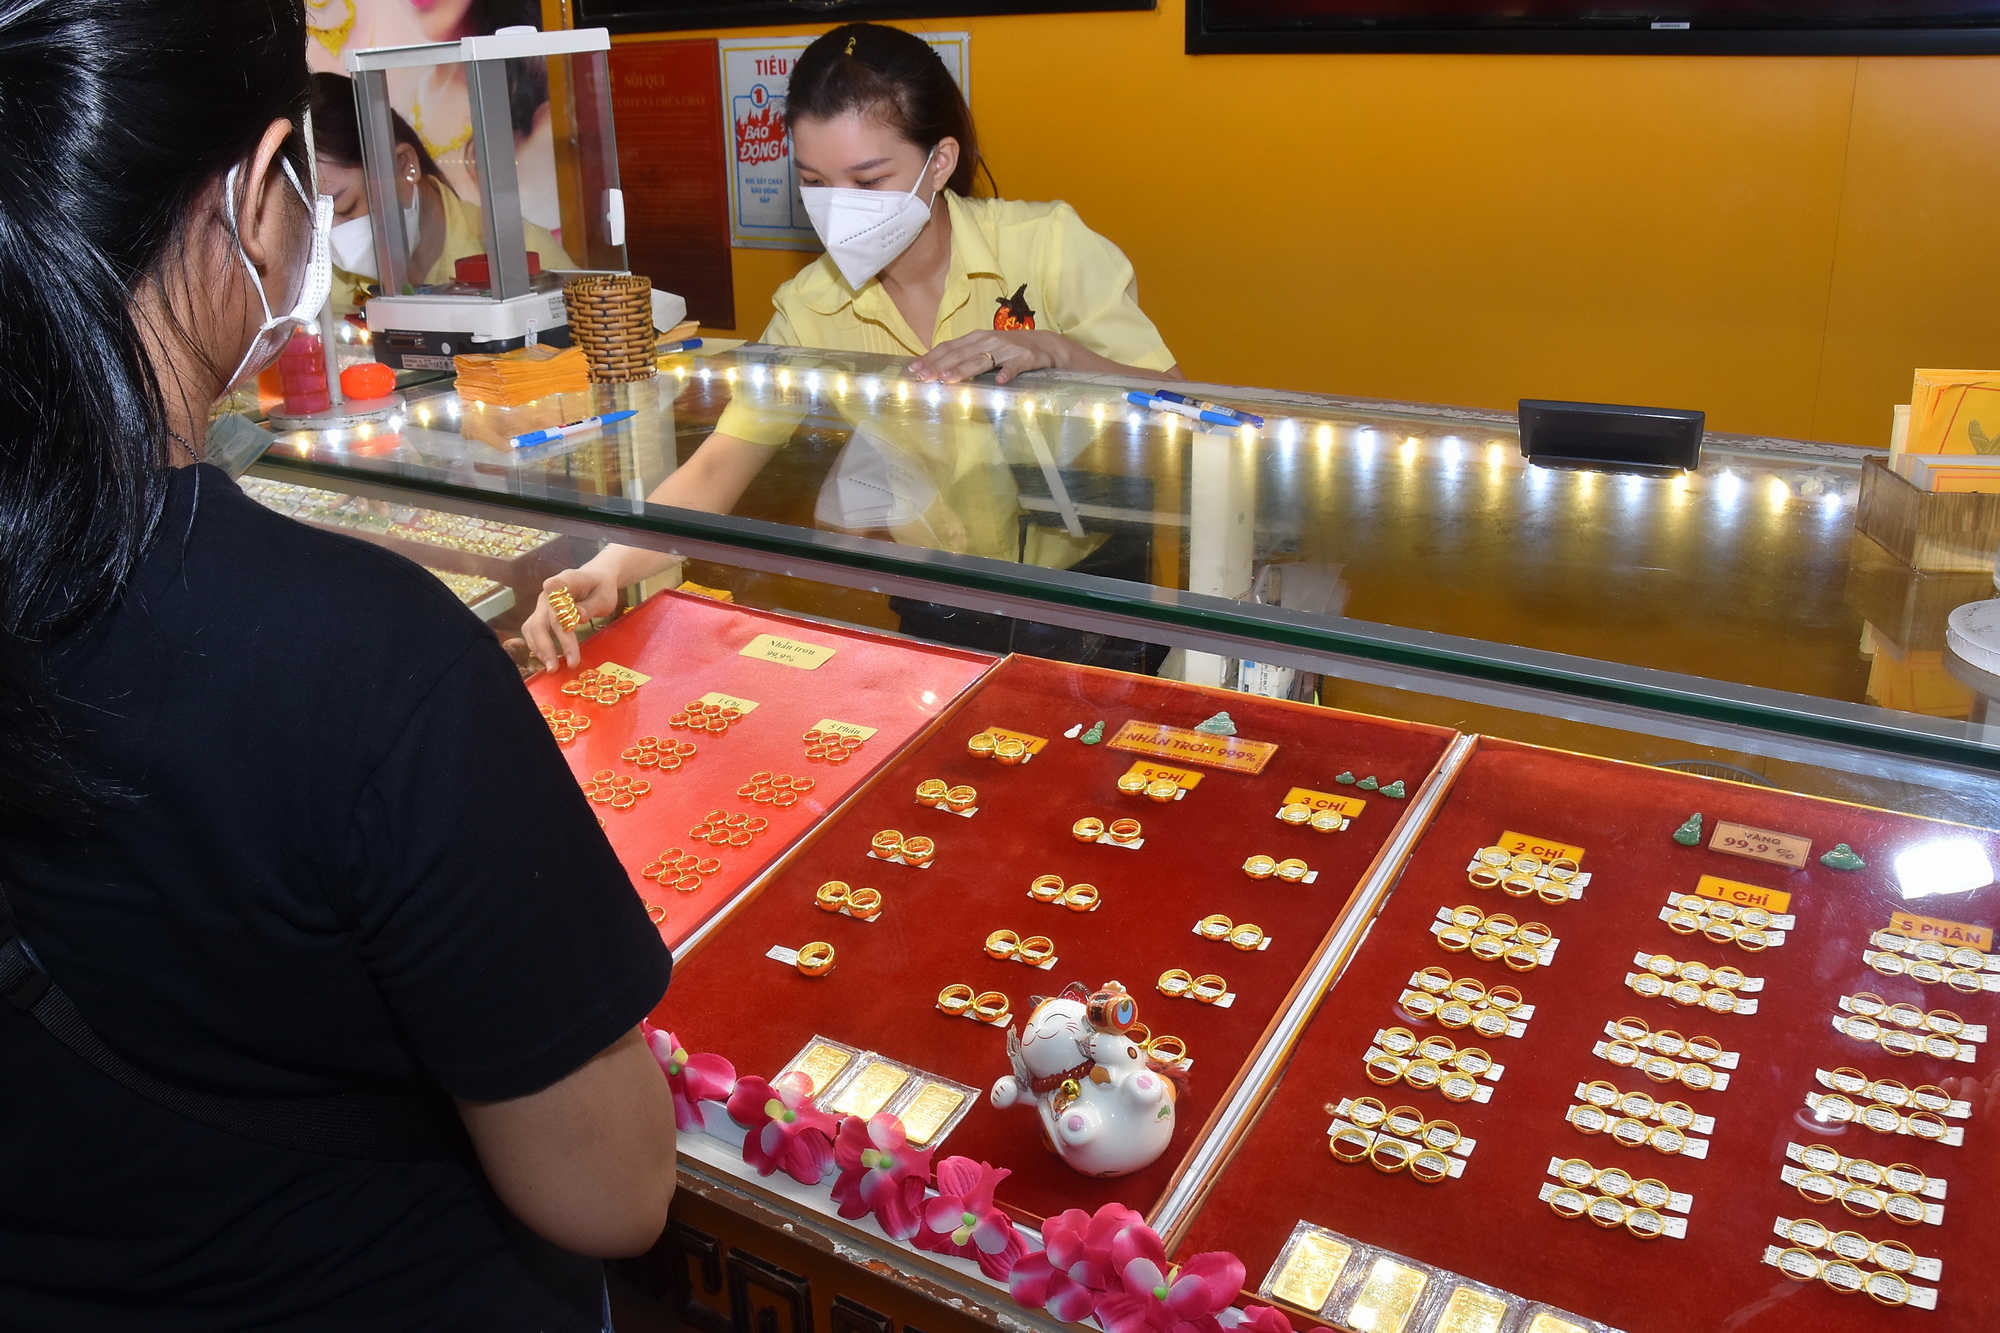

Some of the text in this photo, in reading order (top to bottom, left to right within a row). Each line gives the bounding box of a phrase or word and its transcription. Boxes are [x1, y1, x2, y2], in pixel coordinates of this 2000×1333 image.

[755, 55, 787, 76] TIÊU
[754, 88, 763, 104] 1
[745, 122, 769, 140] BÁO
[740, 140, 779, 163] ĐỘNG
[1125, 730, 1169, 747] NHẪN
[1217, 748, 1257, 763] 999%
[1143, 768, 1154, 777] 5
[1300, 797, 1311, 805] 3
[1514, 842, 1526, 851] 2
[1744, 831, 1781, 846] VÀNG
[1717, 886, 1770, 906] 1 CHỈ
[1920, 923, 1981, 944] PHÂN
